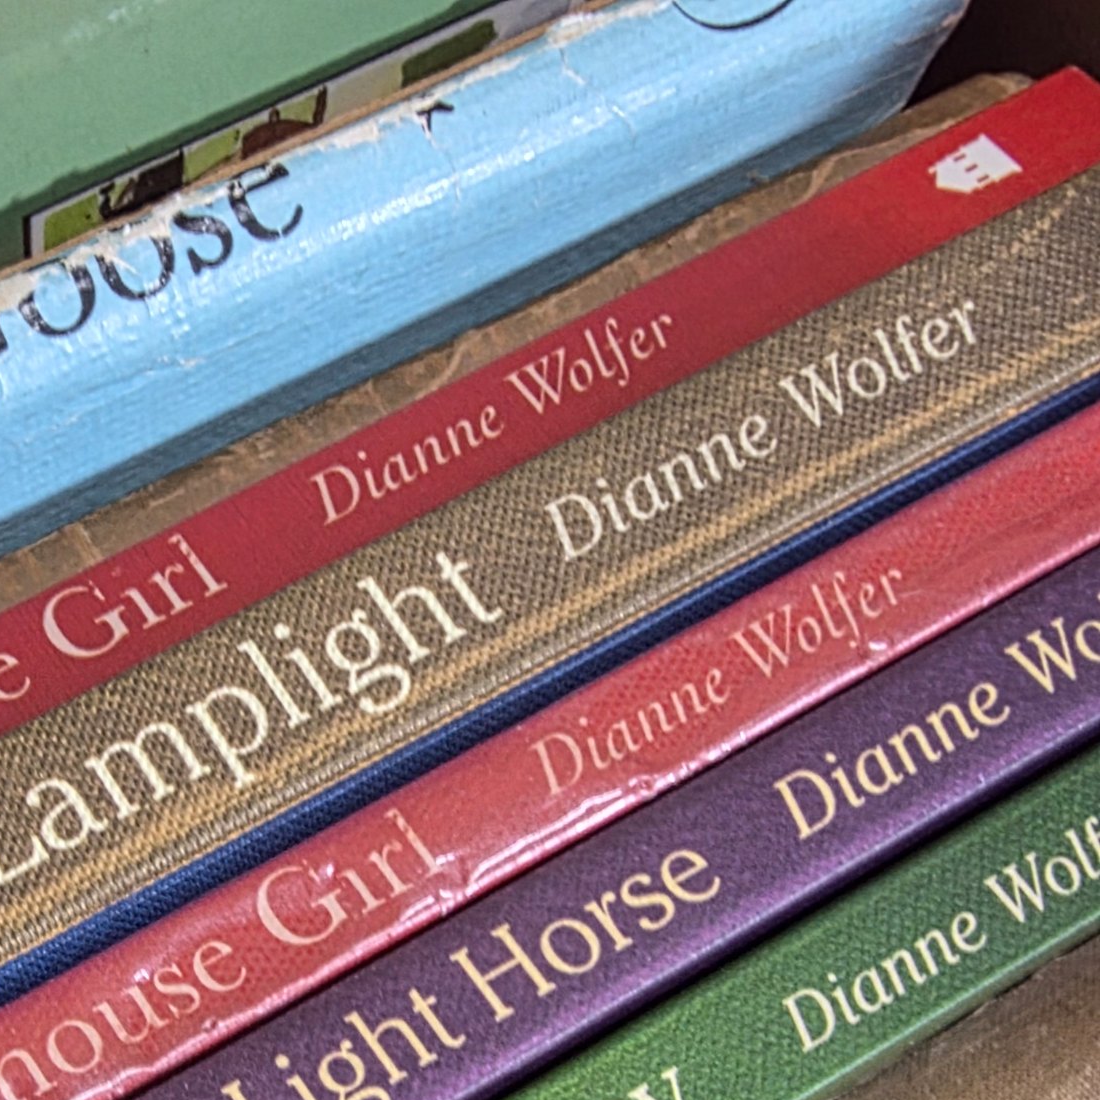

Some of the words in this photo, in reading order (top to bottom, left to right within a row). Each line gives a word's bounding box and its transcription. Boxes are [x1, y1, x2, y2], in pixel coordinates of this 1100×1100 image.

[42, 533, 228, 660] Girl
[309, 405, 505, 525] Dianne
[505, 312, 674, 416] Wolfer
[545, 412, 779, 562] Dianne
[778, 300, 978, 430] Wolfer
[255, 807, 445, 949] Girl
[528, 665, 732, 797] Dianne
[731, 568, 902, 678] Wolfer
[451, 847, 722, 1024] Horse
[773, 683, 1010, 840] Dianne
[782, 911, 987, 1053] Dianne
